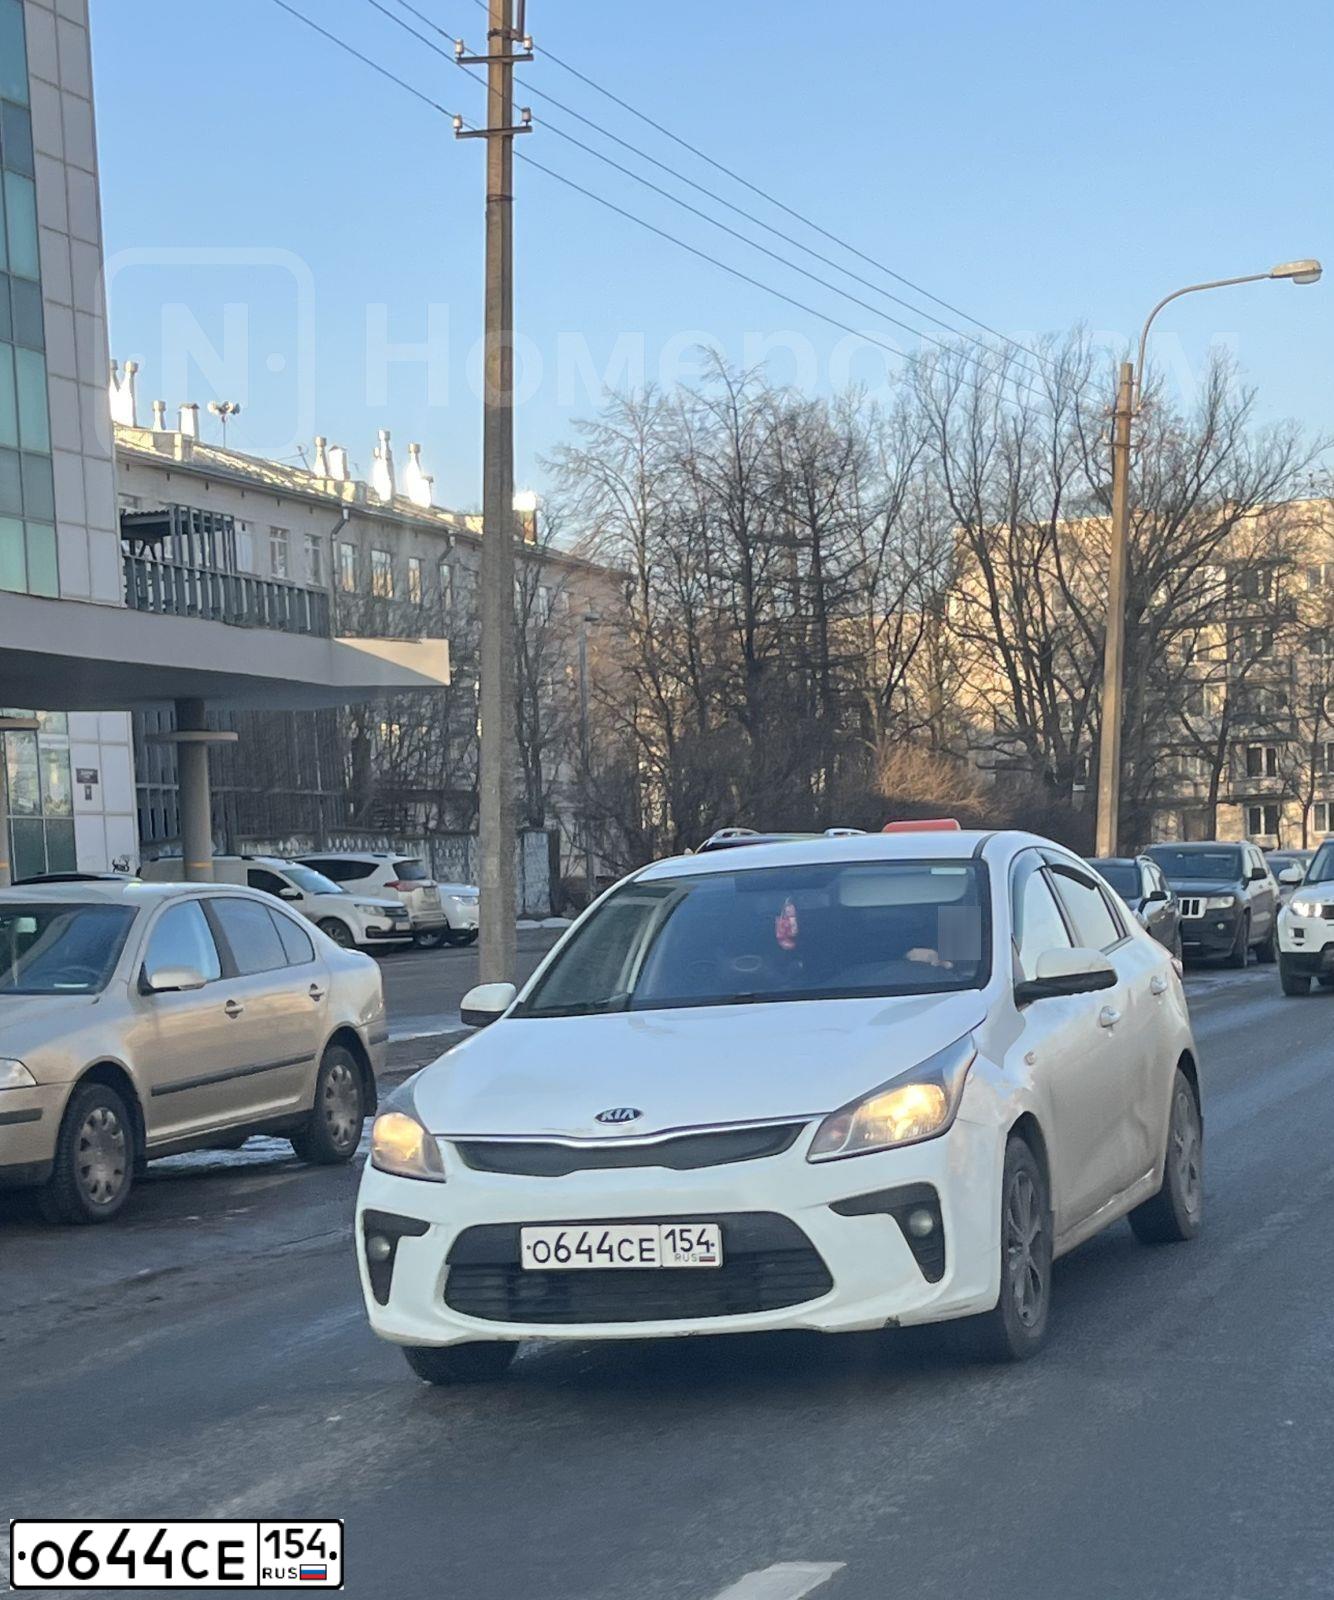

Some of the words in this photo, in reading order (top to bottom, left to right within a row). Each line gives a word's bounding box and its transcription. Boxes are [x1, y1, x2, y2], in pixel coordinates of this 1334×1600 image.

[599, 1108, 636, 1122] KIA
[664, 1228, 710, 1253] 154
[674, 1253, 698, 1262] RUS
